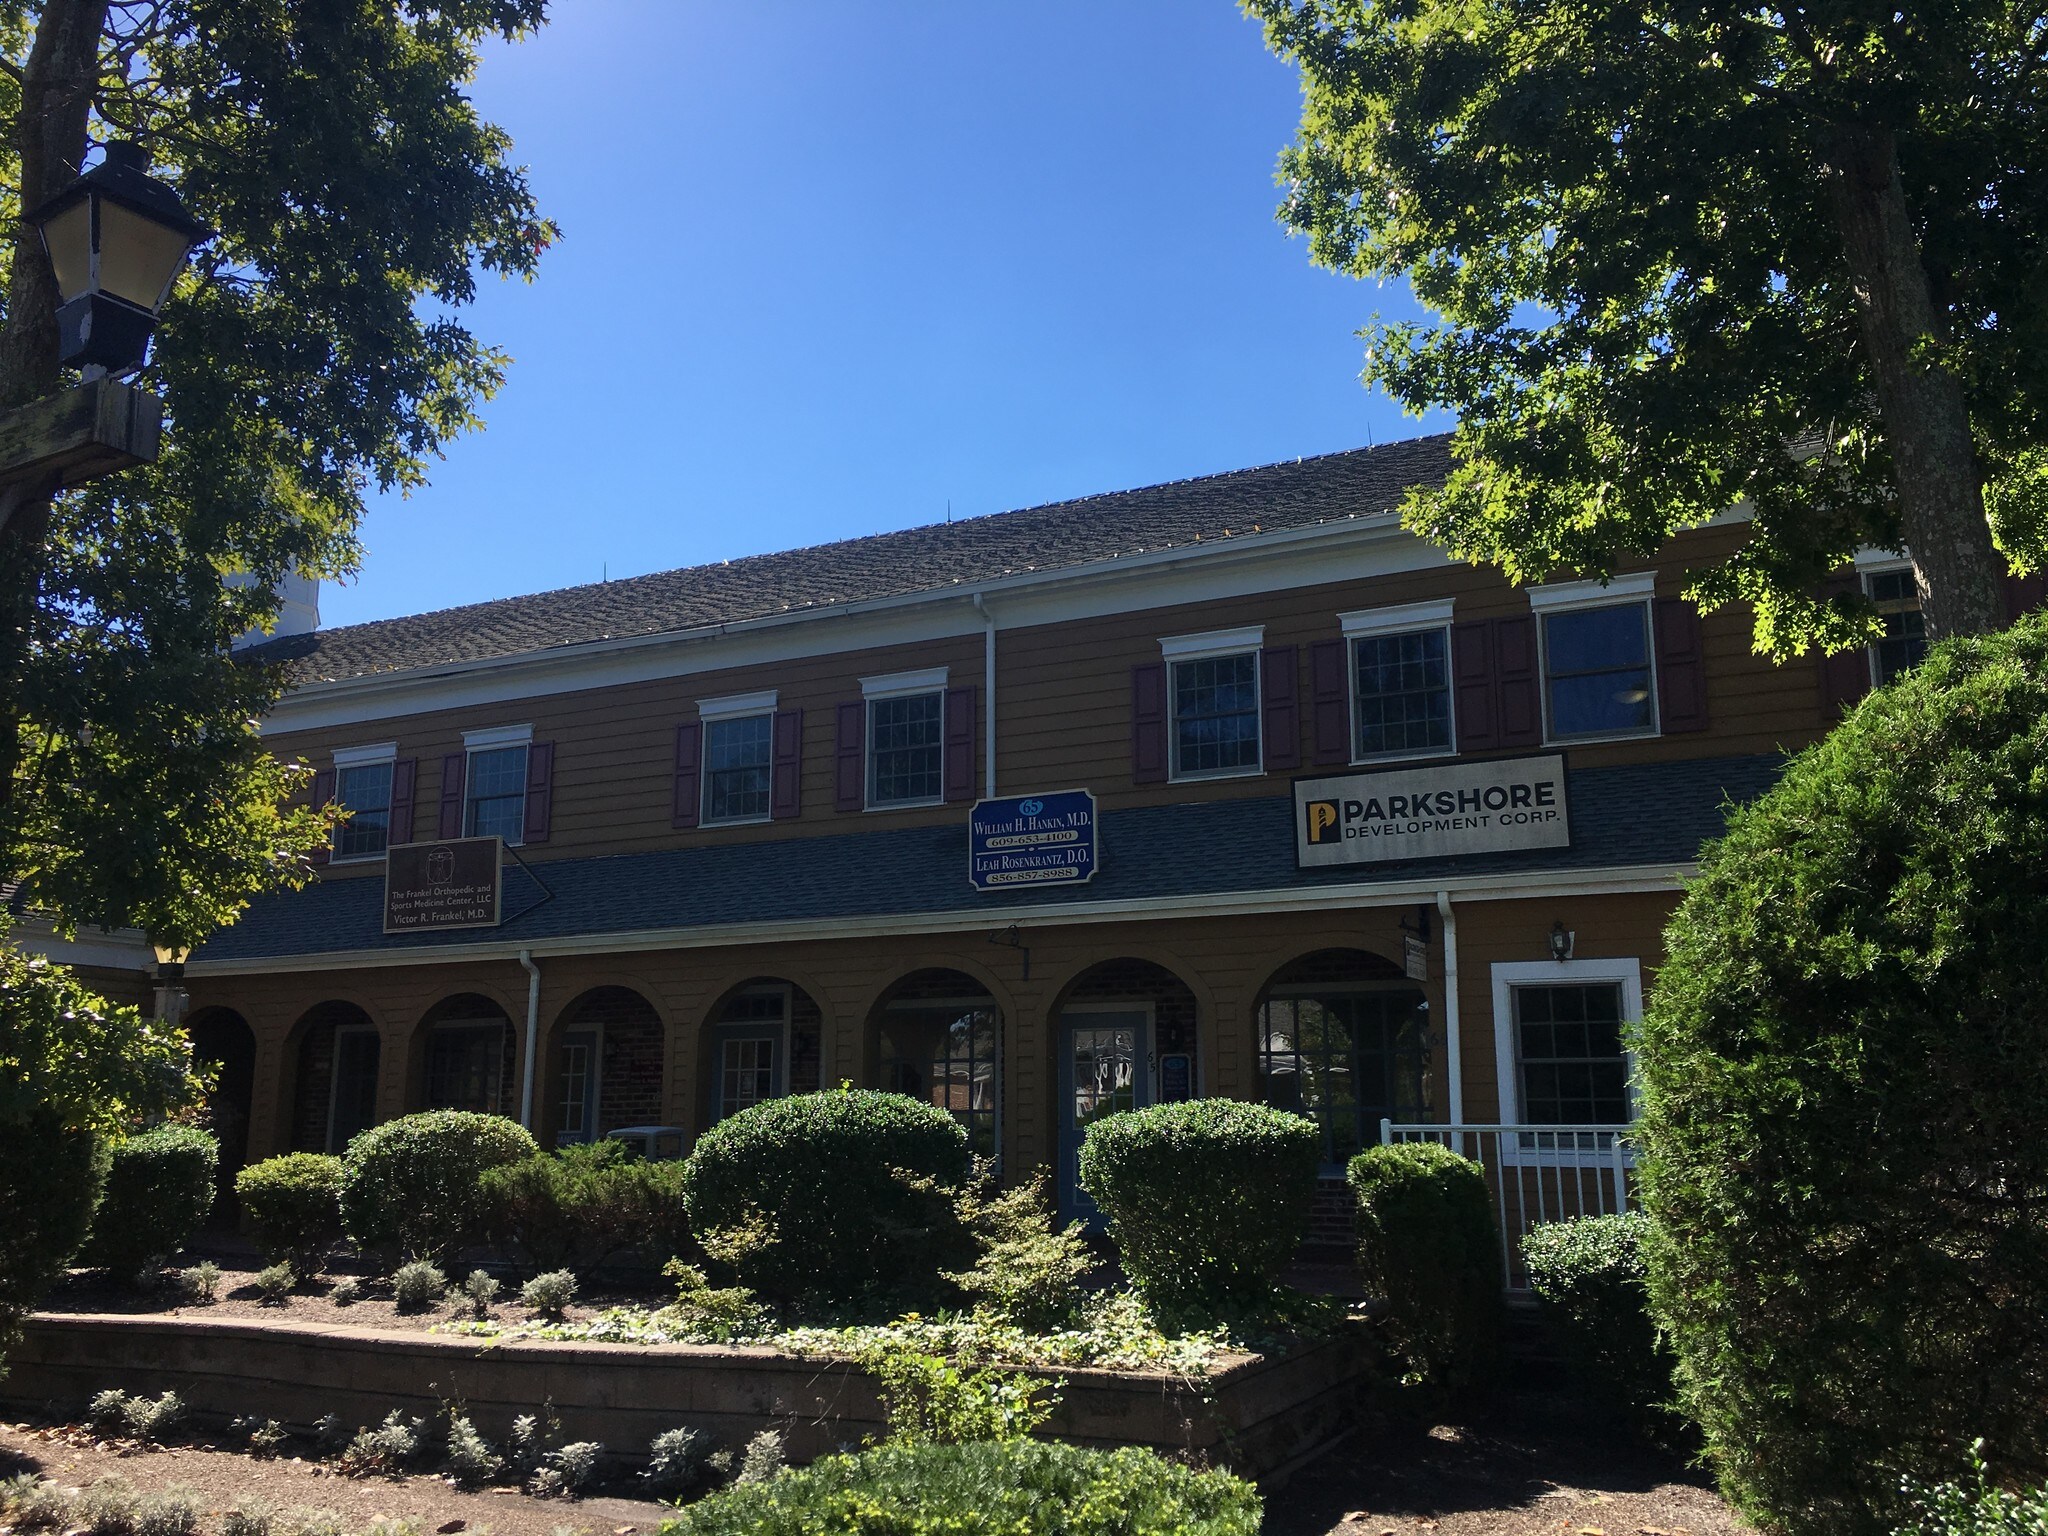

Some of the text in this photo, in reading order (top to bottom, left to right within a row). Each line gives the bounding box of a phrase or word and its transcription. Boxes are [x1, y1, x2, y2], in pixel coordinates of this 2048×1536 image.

[1022, 801, 1039, 814] 65
[1343, 781, 1556, 824] PARKSHORE
[1015, 817, 1026, 832] H.
[1067, 811, 1091, 827] M.D.
[1345, 810, 1561, 839] DEVELOPMENT CORP.
[991, 832, 1072, 847] 609-653-4100
[1067, 848, 1090, 864] D.O.
[991, 868, 1073, 883] 856-857-8988
[392, 884, 491, 900] The Frankel Orthopedic and
[390, 901, 412, 911] Sports
[414, 899, 444, 908] Medicine
[476, 894, 492, 903] LLC
[394, 909, 487, 924] Victor R. Frankel, M.D.
